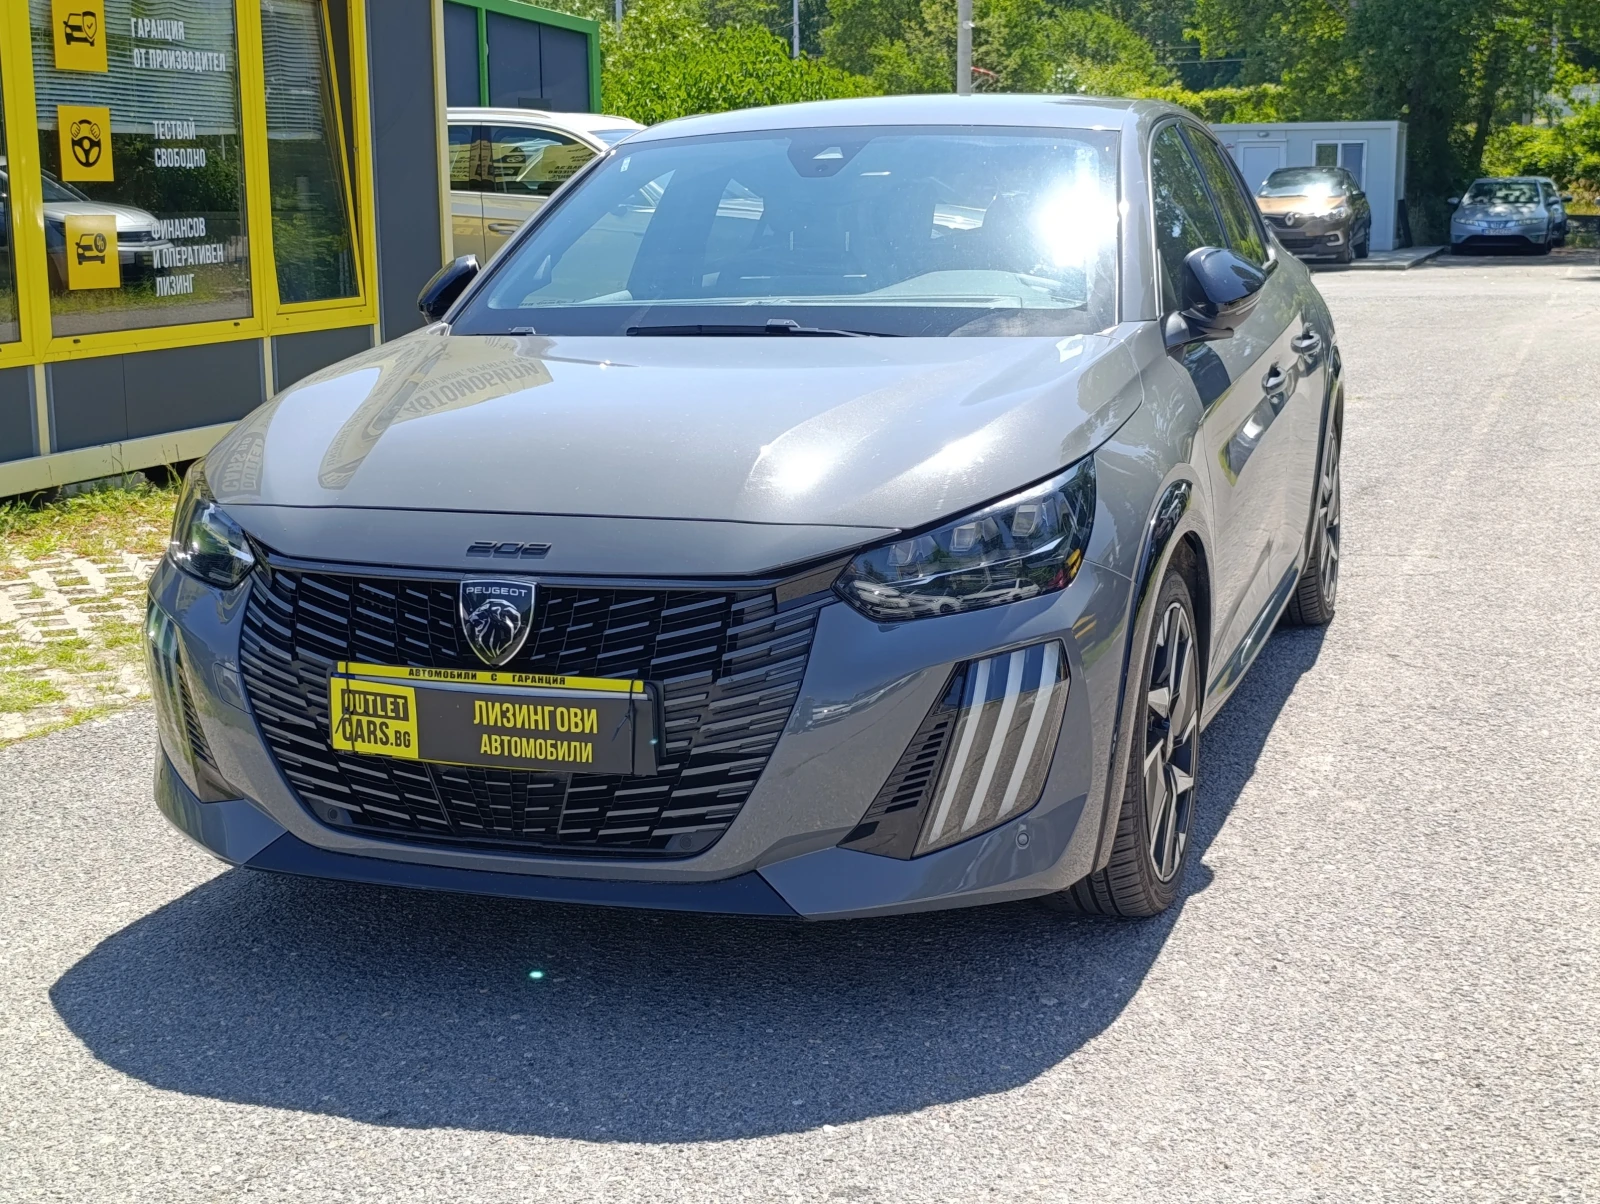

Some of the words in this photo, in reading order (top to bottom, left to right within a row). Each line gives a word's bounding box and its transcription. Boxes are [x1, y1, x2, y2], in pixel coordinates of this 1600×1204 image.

[131, 18, 185, 41] ГАРАНЦИЯ
[133, 49, 147, 68] ОТ
[149, 49, 226, 72] ПРОИЗВОДИТЕЛ
[153, 117, 196, 140] ТЕСТВАЙ
[154, 147, 206, 169] СВОБОДНО
[151, 217, 206, 241] ФИНАНСОВ
[153, 250, 161, 269] И
[161, 243, 224, 268] ОПЕРАТИВЕН
[156, 274, 195, 297] ЛИЗИНГ
[465, 540, 552, 559] 208
[466, 586, 528, 597] PEUGEOT
[408, 668, 477, 681] АВТОМОБИЛИ
[490, 673, 498, 682] С
[512, 674, 566, 686] ГАРАНЦИЯ
[344, 693, 405, 718] OUTLET
[473, 700, 599, 734] ЛИЗИНГОВИ
[341, 717, 411, 749] CARS.BG
[480, 734, 593, 763] АВТОМОБИЛИ
